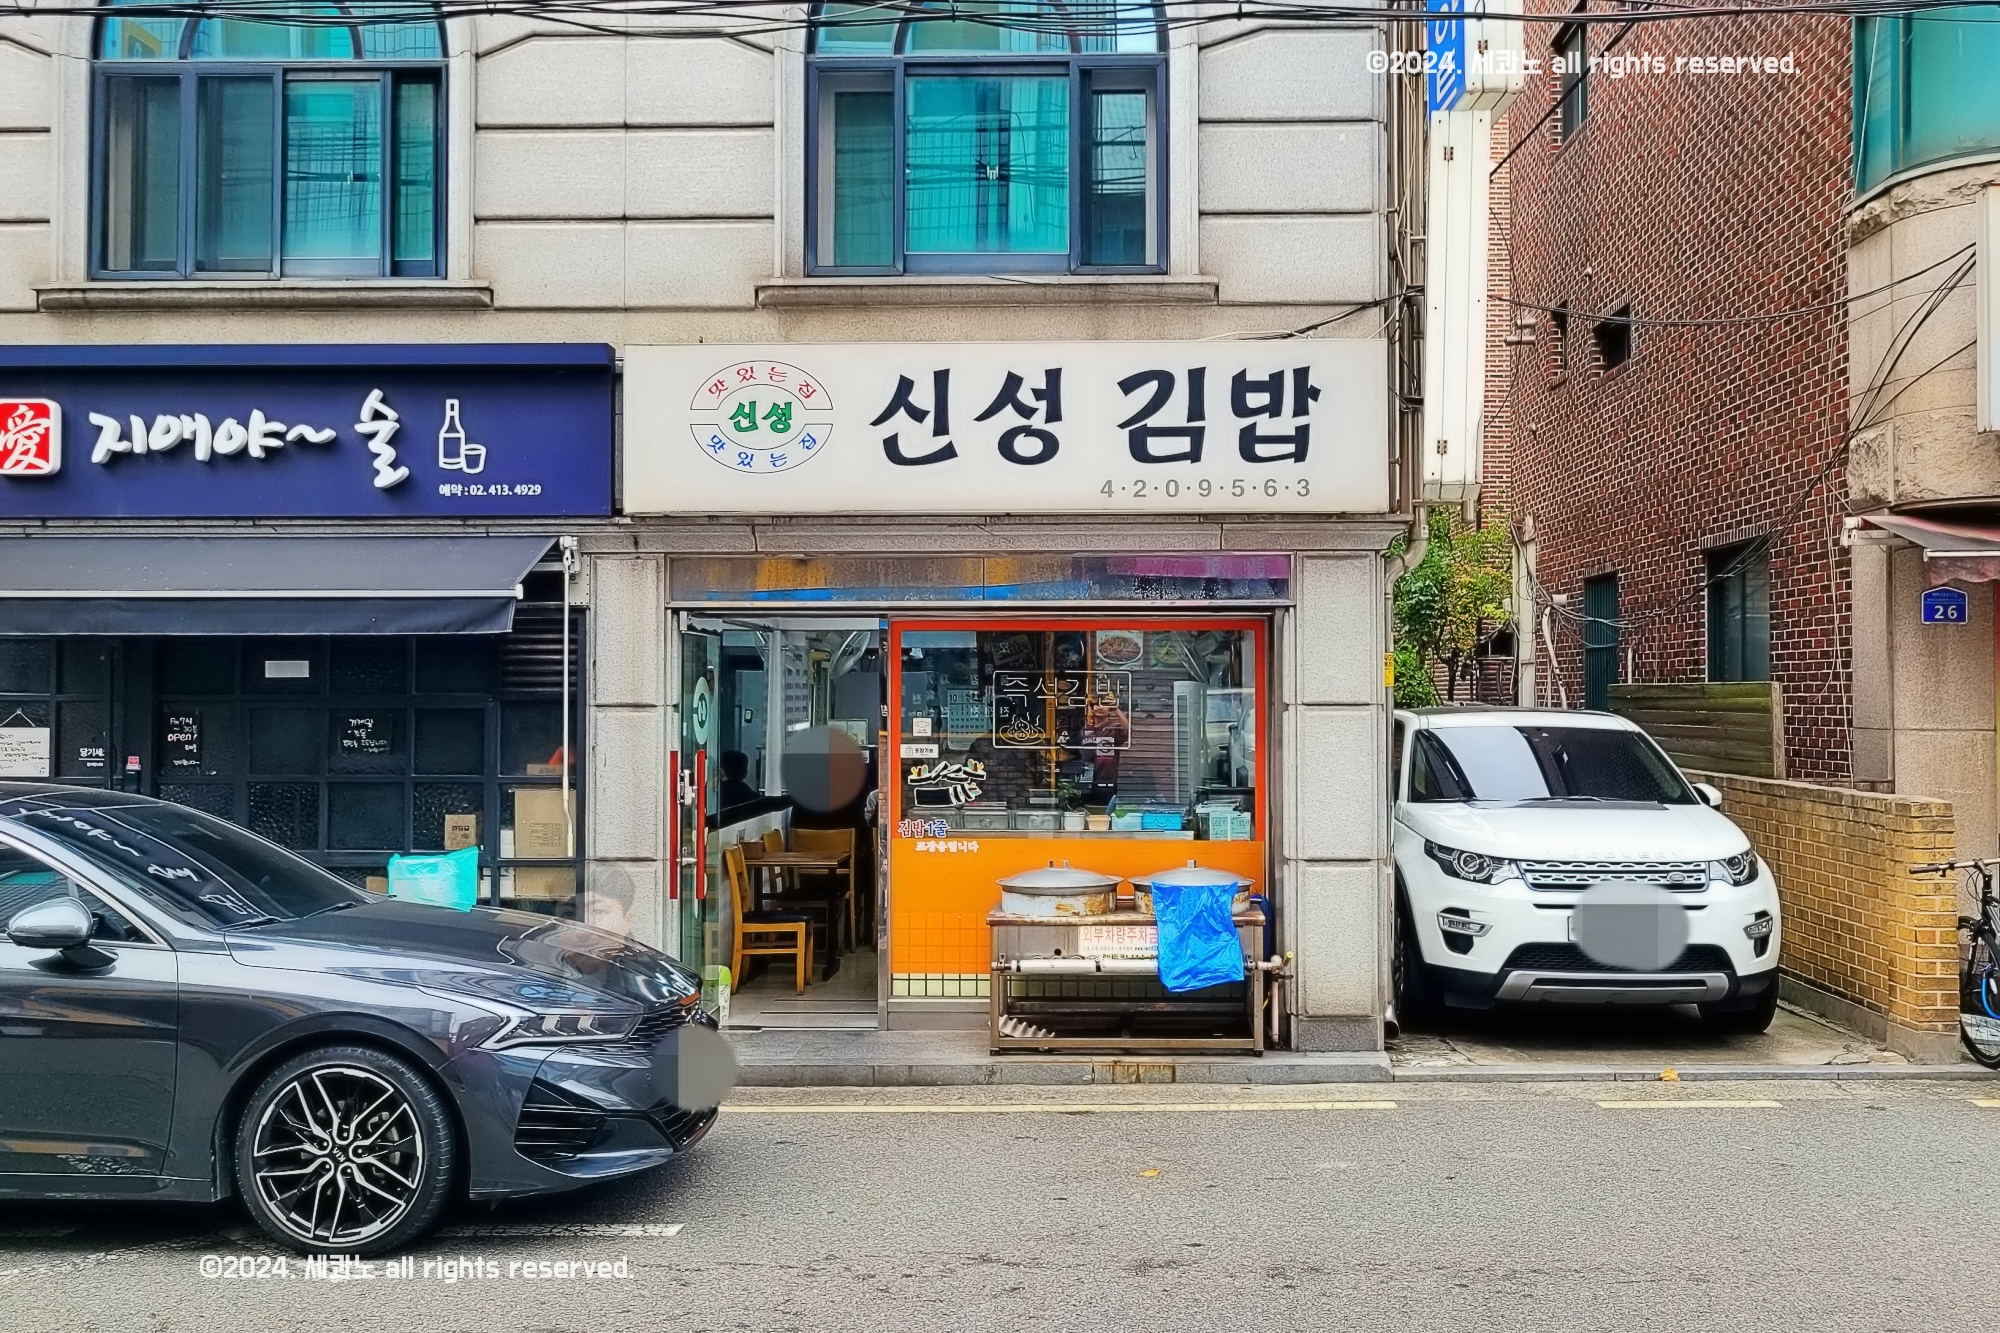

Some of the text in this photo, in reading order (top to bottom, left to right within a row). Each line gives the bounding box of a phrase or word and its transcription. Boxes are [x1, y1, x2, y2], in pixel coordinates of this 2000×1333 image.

[708, 366, 817, 400] 맛있는 집
[728, 400, 793, 434] 신성
[869, 366, 1322, 466] 신성 김밥
[0, 404, 51, 470] 愛
[354, 388, 410, 489] 술
[706, 432, 817, 468] 맛있는 집
[1934, 605, 1958, 620] 26
[1003, 675, 1125, 708] 즉석김밥
[1541, 850, 1685, 860] SCOVERY
